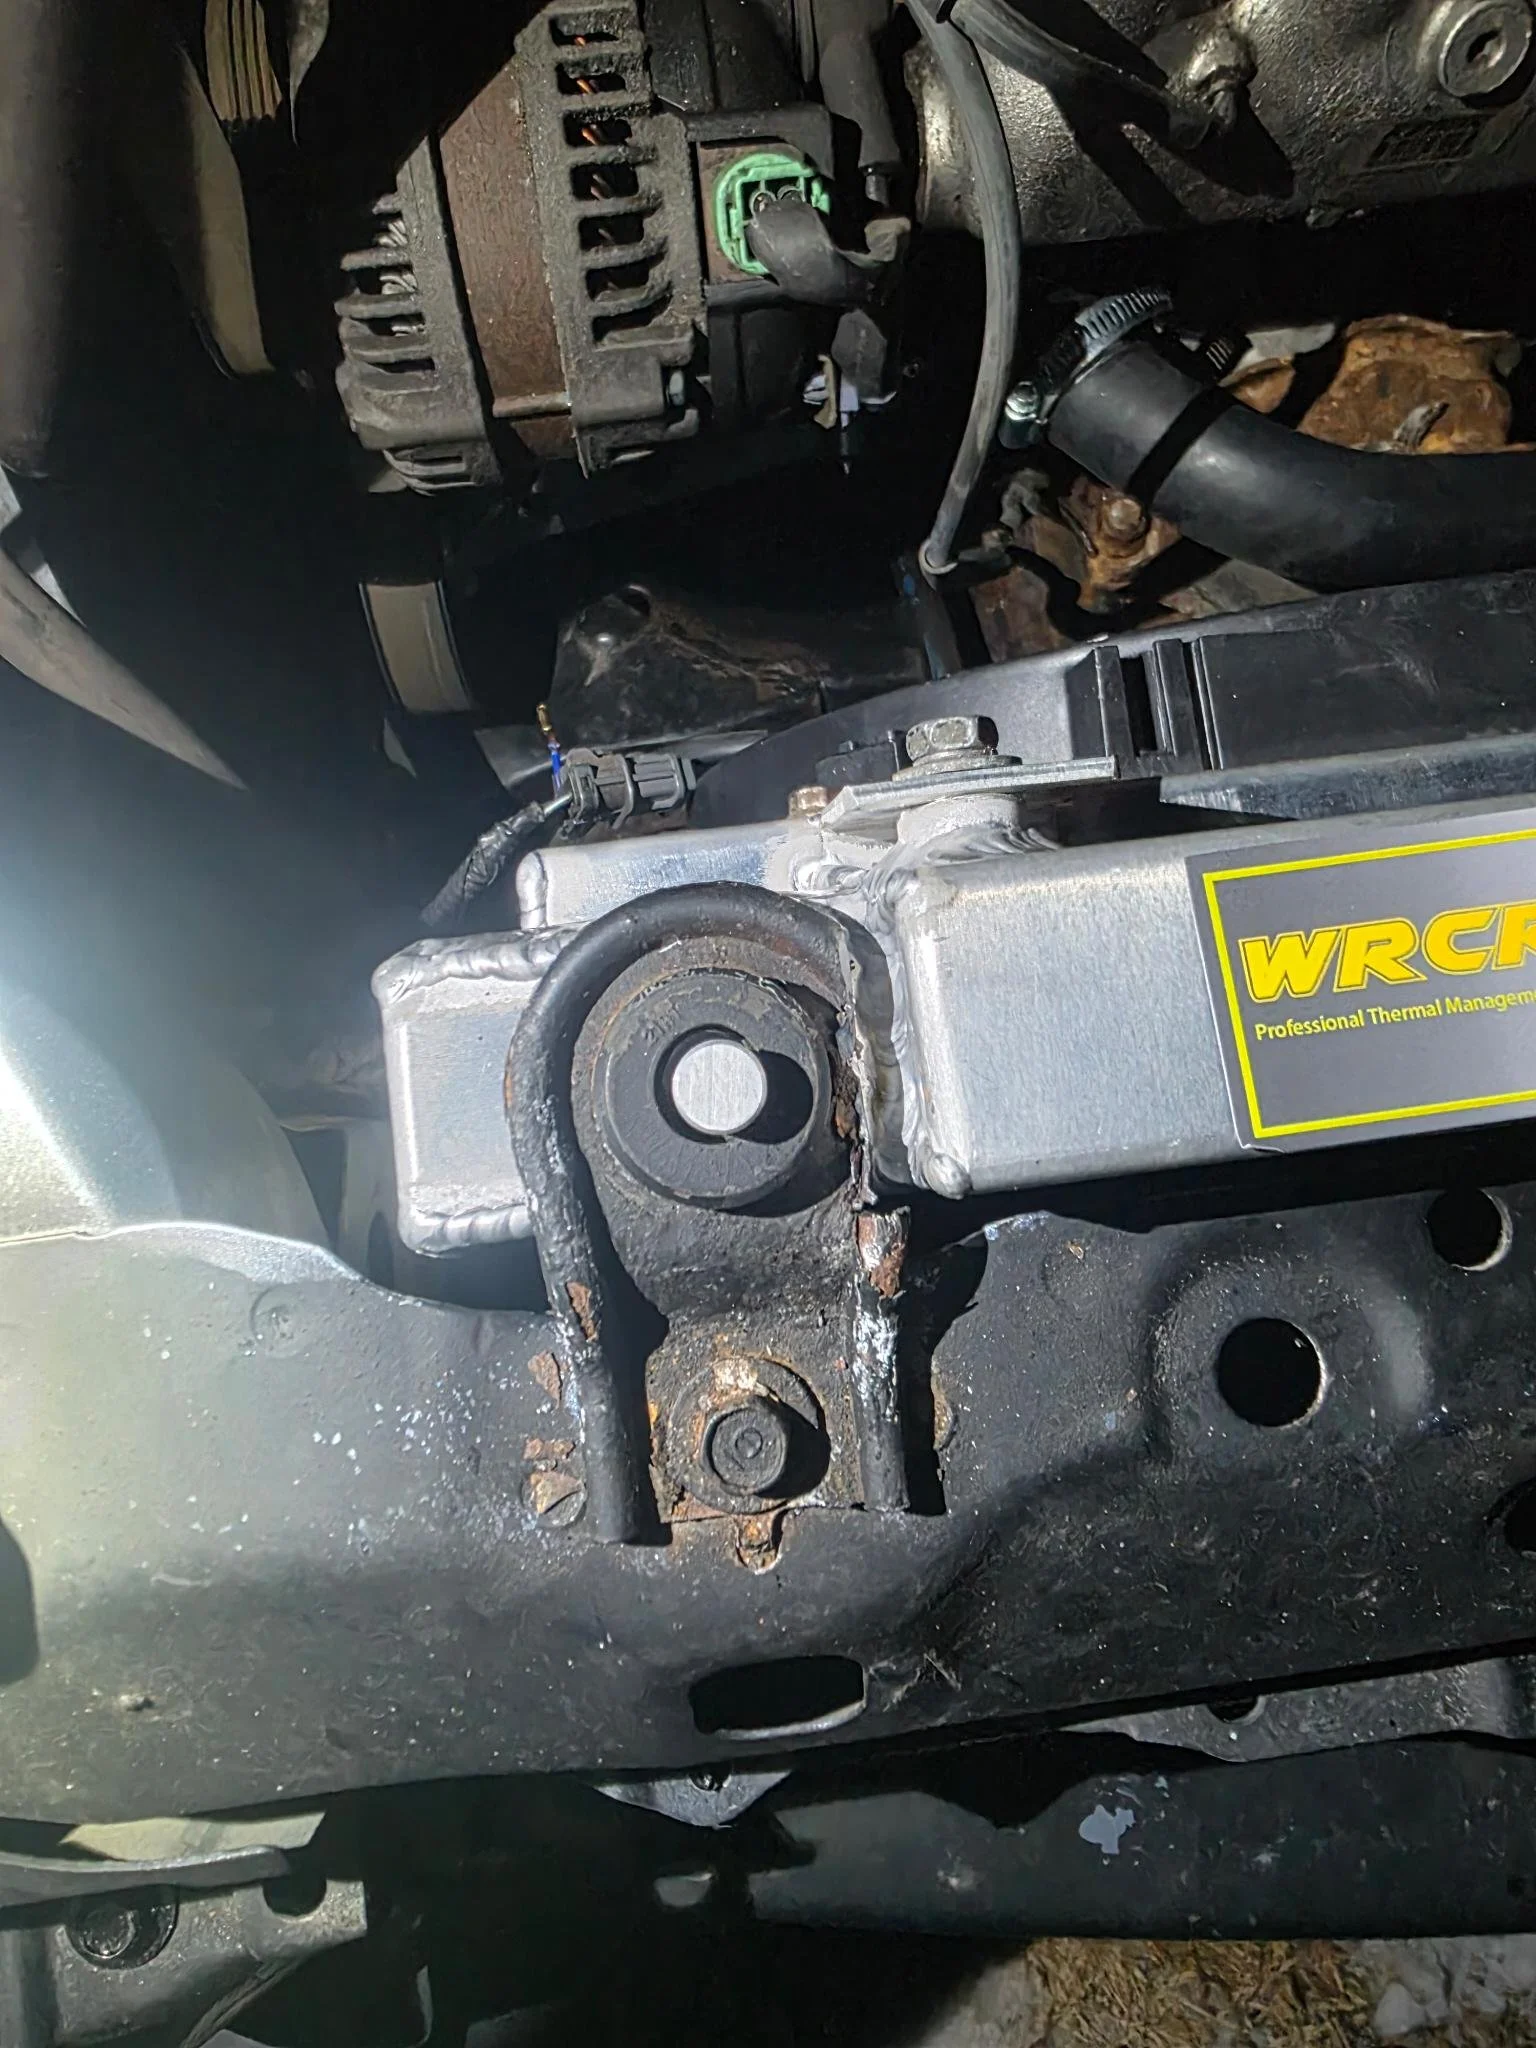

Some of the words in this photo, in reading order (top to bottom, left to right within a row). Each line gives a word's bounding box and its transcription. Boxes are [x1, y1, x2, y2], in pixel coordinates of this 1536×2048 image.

[1254, 1009, 1365, 1041] Professional
[1366, 999, 1442, 1025] Thermal
[1445, 989, 1536, 1015] Managem
